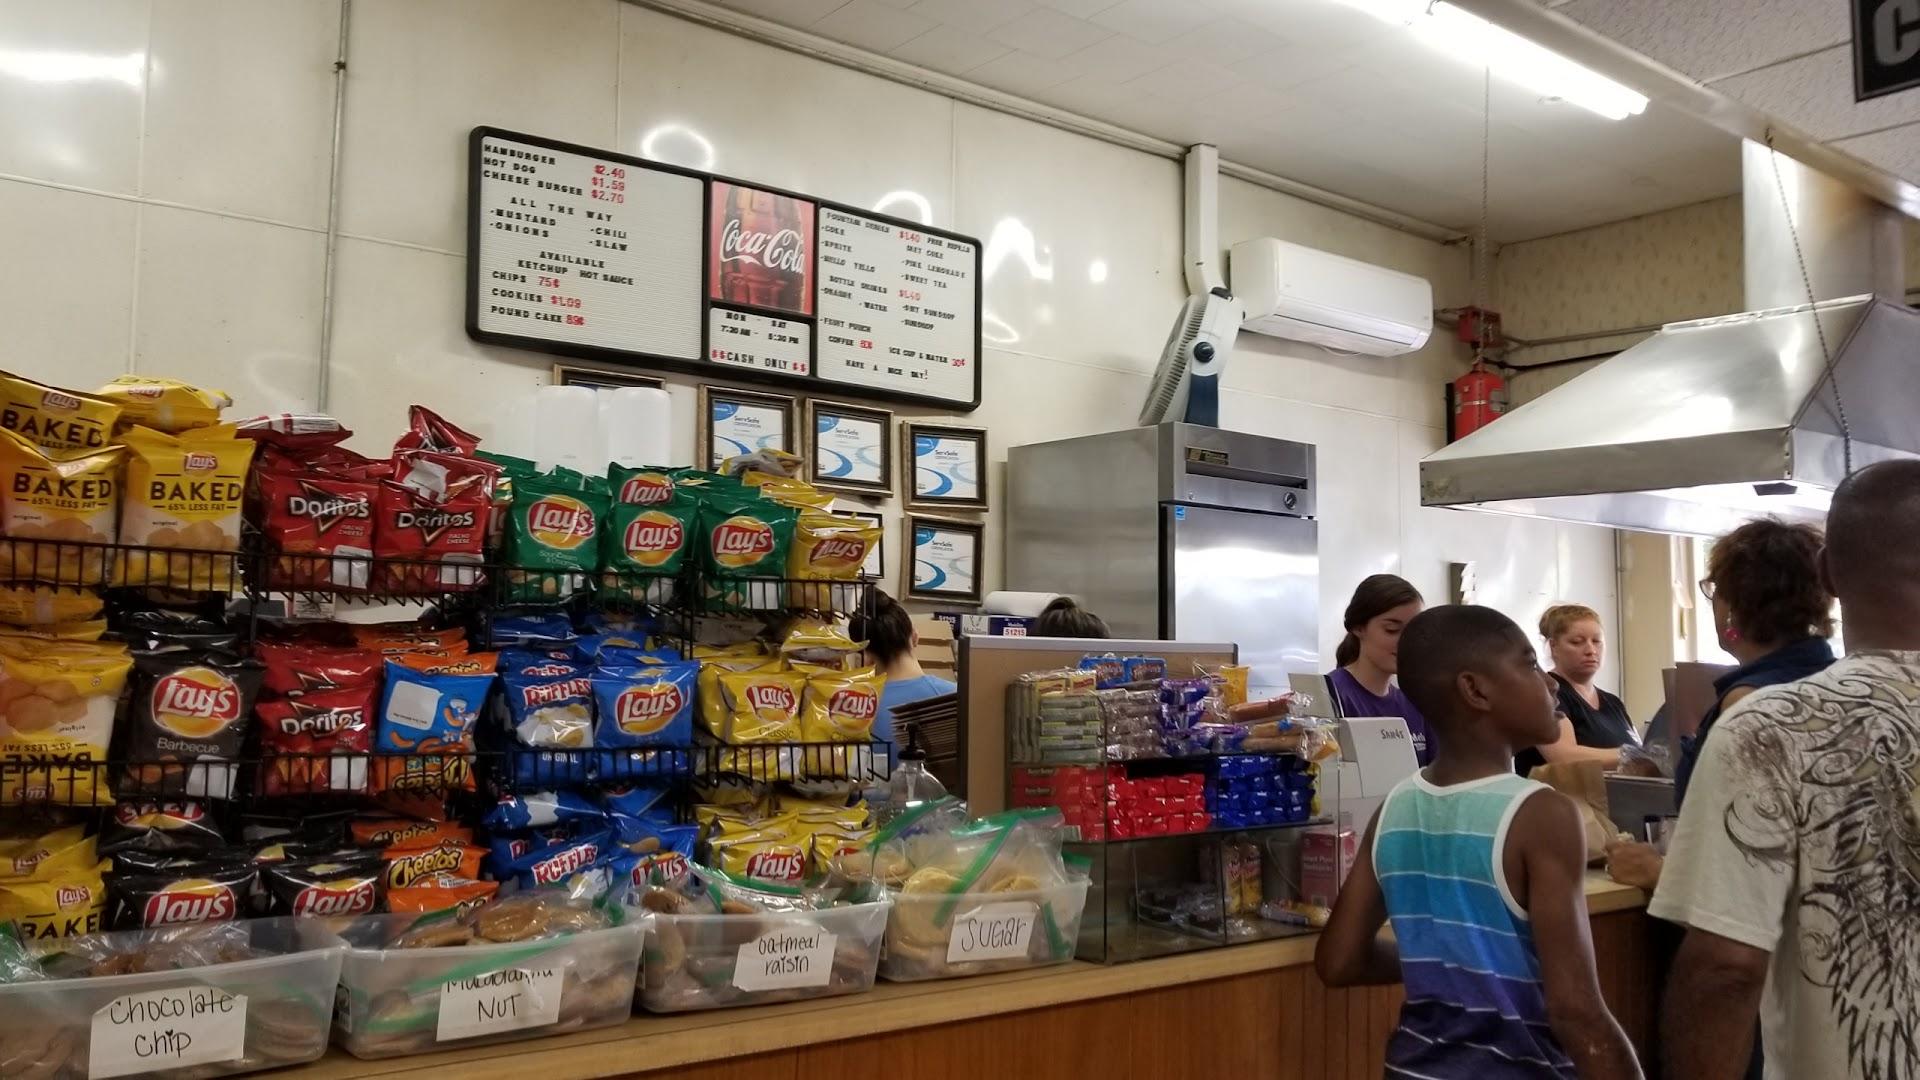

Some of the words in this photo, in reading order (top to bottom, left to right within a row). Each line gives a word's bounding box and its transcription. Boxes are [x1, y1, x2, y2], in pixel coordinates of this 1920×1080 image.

[483, 156, 506, 168] HOT
[513, 162, 536, 174] DOG
[484, 144, 556, 166] HAMBURGER
[483, 170, 530, 186] CHEESE
[537, 180, 583, 196] BURGER
[591, 189, 625, 204] $2.70
[510, 196, 537, 209] ALL
[548, 203, 574, 215] THE
[586, 210, 613, 222] WAY
[720, 219, 806, 276] Coca-Cola
[539, 251, 605, 269] AVAILABLE
[492, 271, 527, 284] CHIPS
[518, 260, 568, 275] KETCHUP
[579, 269, 600, 281] HOT
[603, 274, 634, 286] SAUCE
[491, 287, 543, 303] COOKIES
[490, 305, 530, 319] POUND
[535, 312, 563, 323] CAKE
[726, 312, 746, 322] MON
[764, 357, 788, 370] ONLY
[1, 410, 103, 448] BAKED
[185, 452, 217, 471] Lay's
[13, 472, 112, 500] BAKED
[150, 481, 242, 502] BAKED
[31, 496, 51, 505] 65%
[55, 499, 79, 510] LESS
[81, 501, 97, 510] FAT
[168, 503, 187, 511] 65%
[188, 503, 213, 512] LESS
[214, 503, 226, 512] FAT
[289, 496, 370, 518] Doritos
[397, 511, 474, 529] Doritos
[531, 503, 592, 540] Lay's
[630, 521, 681, 552] Lay's
[716, 526, 772, 555] Lay's
[812, 538, 864, 561] Lay's
[1005, 628, 1026, 637] 51215
[157, 678, 235, 718] Lay's
[524, 678, 592, 708] RUFFLES
[754, 685, 792, 710] Lay's
[621, 689, 678, 724] Lay's
[834, 691, 876, 720] Lay's
[280, 710, 363, 735] Doritos
[758, 725, 794, 740] Classic
[156, 737, 220, 754] Barbecue
[387, 847, 463, 889] Cheetos
[531, 844, 598, 884] RUFFLES
[754, 852, 803, 879] Lay's
[60, 885, 88, 907] Lay's
[302, 887, 371, 918] Lay's
[149, 892, 230, 928] Lay's
[758, 932, 820, 955] oatmeal
[764, 954, 809, 977] raisin
[478, 993, 522, 1023] NUT
